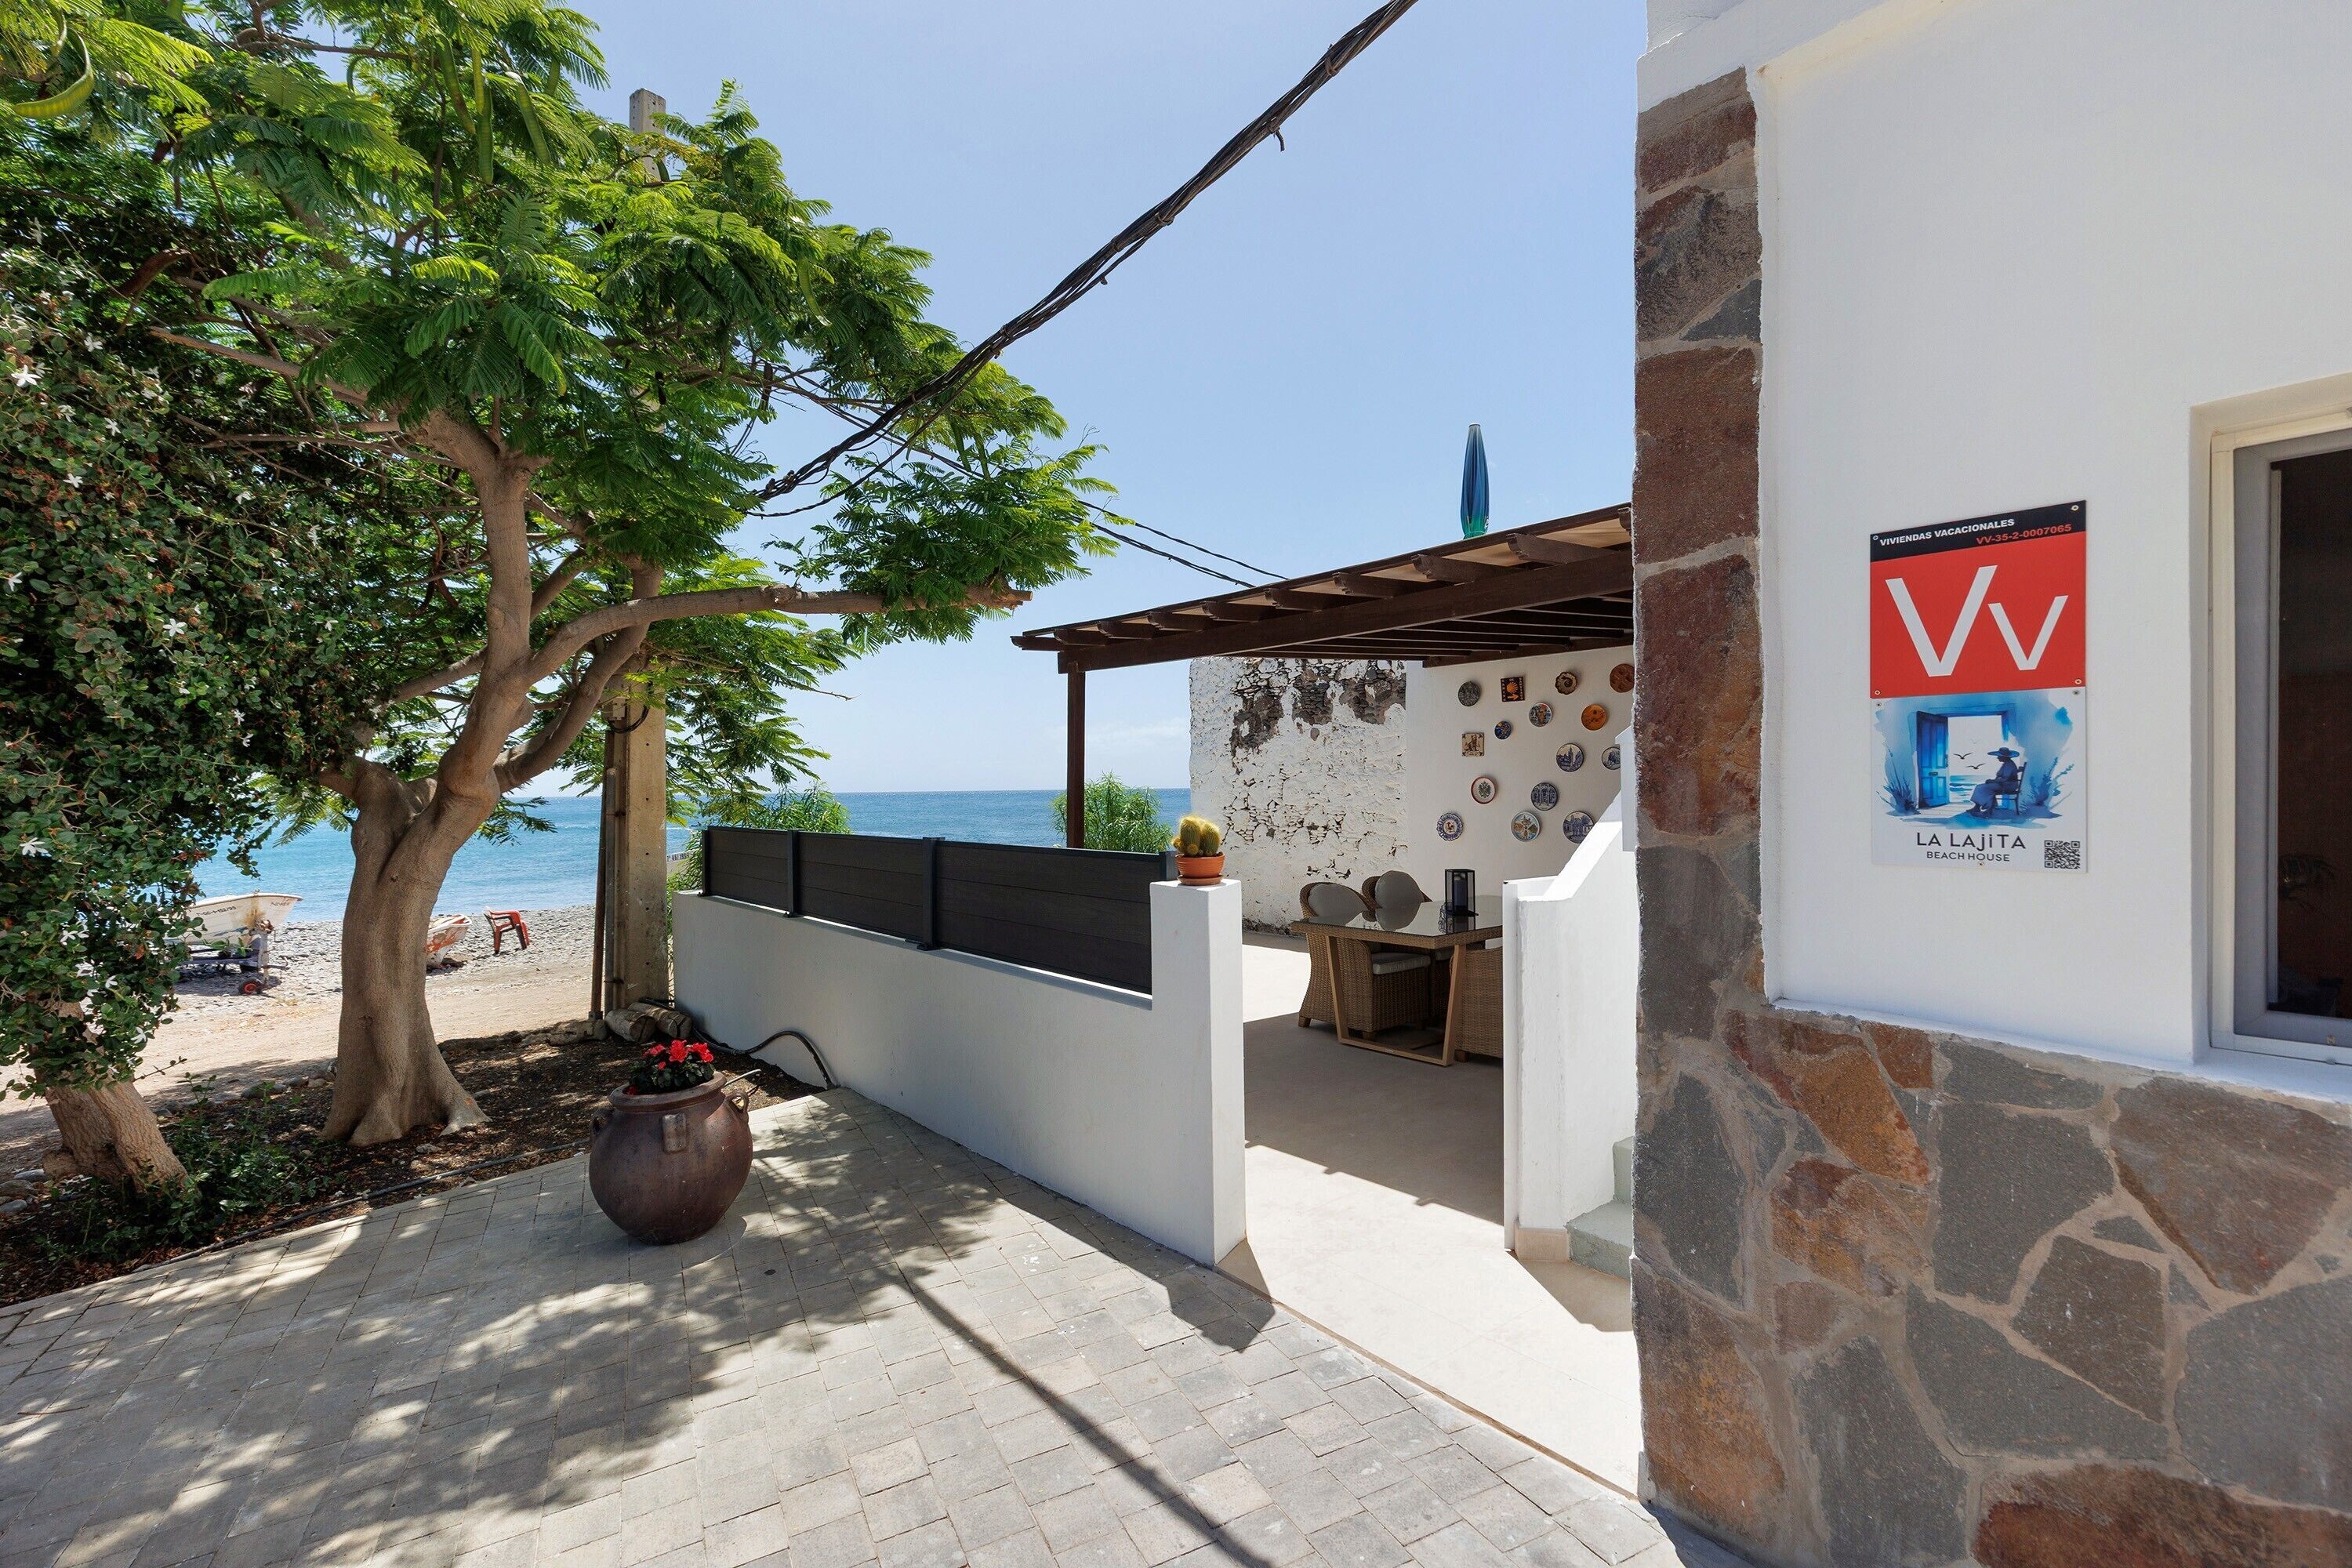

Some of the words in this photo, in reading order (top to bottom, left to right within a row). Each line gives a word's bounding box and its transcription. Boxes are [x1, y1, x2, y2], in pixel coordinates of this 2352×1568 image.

[1879, 532, 1933, 546] VIVIENDAS
[1934, 518, 2016, 538] VACACIONALES
[1976, 524, 2072, 546] VV-35-2-0007065
[1916, 832, 1942, 848] LA
[1926, 851, 1965, 862] BEACH
[1967, 852, 2010, 863] HOUSE
